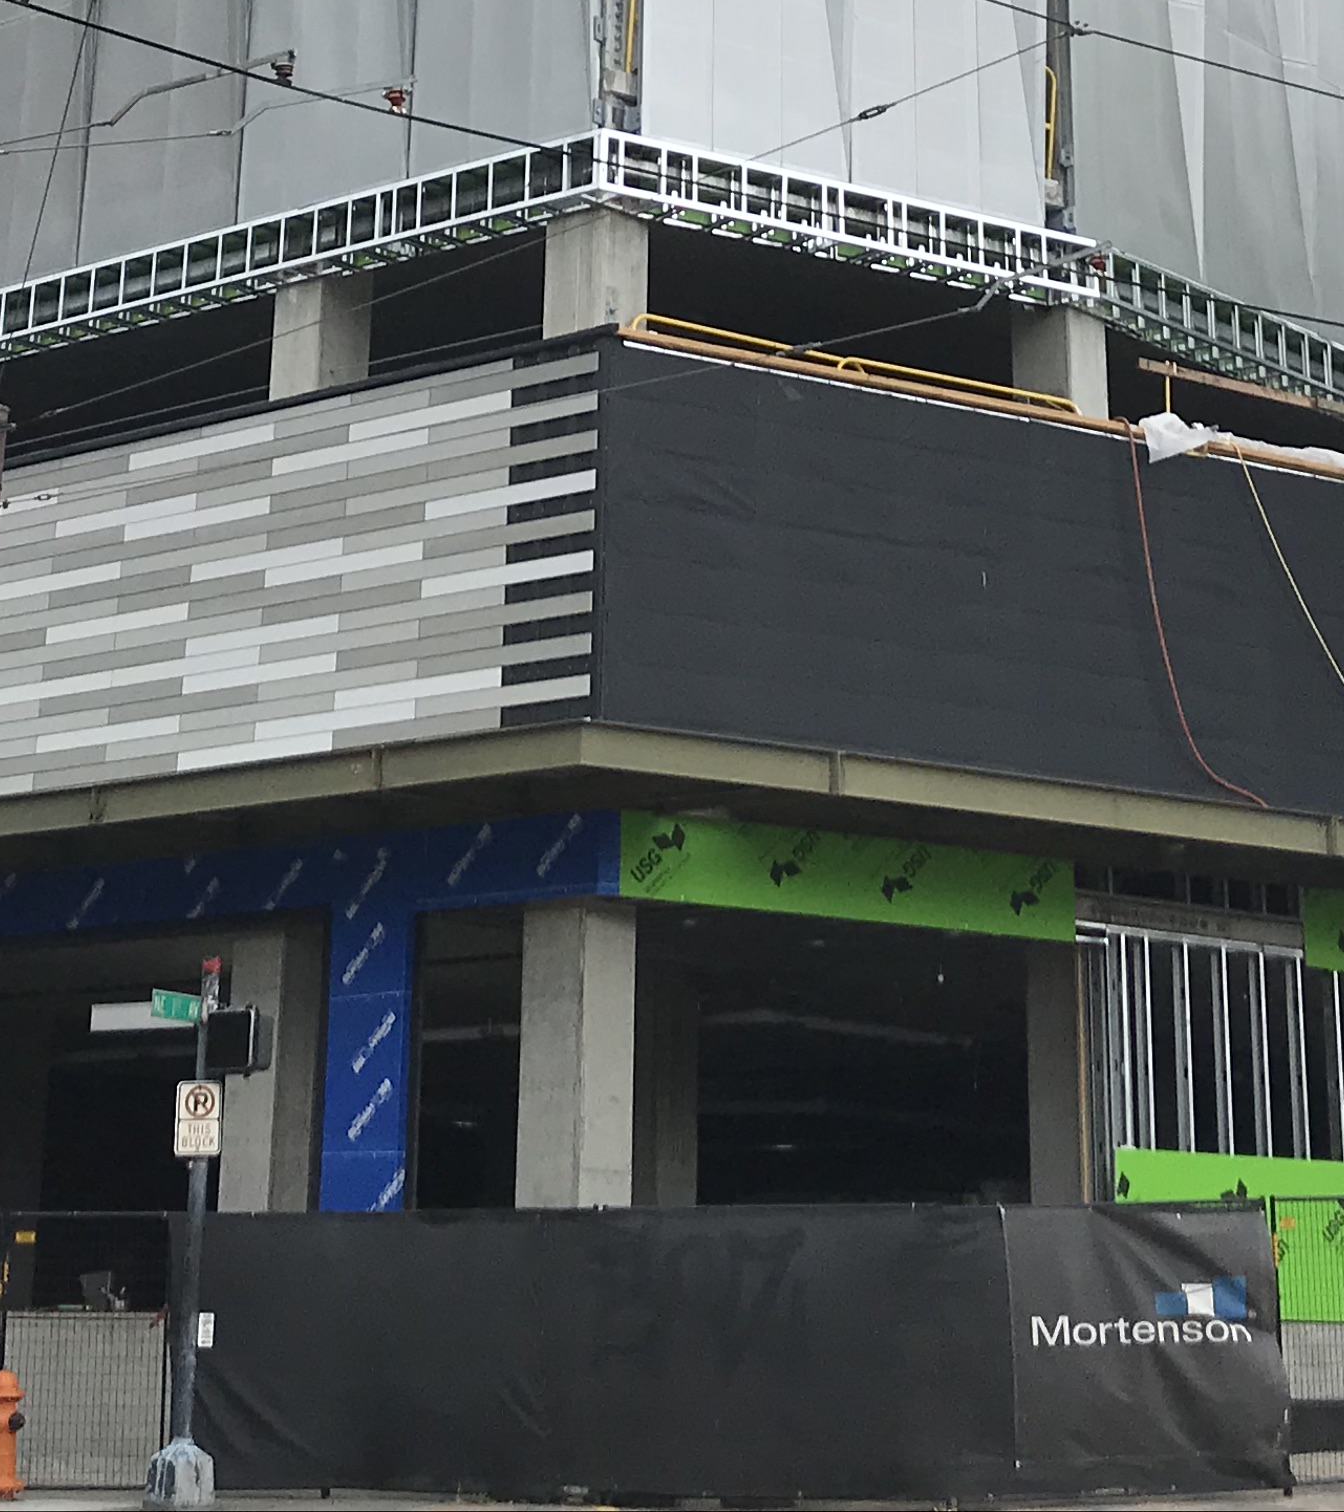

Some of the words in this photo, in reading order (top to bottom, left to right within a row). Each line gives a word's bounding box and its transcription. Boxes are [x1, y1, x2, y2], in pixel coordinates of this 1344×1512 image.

[630, 848, 662, 883] USG
[187, 1123, 212, 1135] THIS
[181, 1136, 216, 1148] BLOCK
[1031, 1314, 1253, 1347] Mortenson
